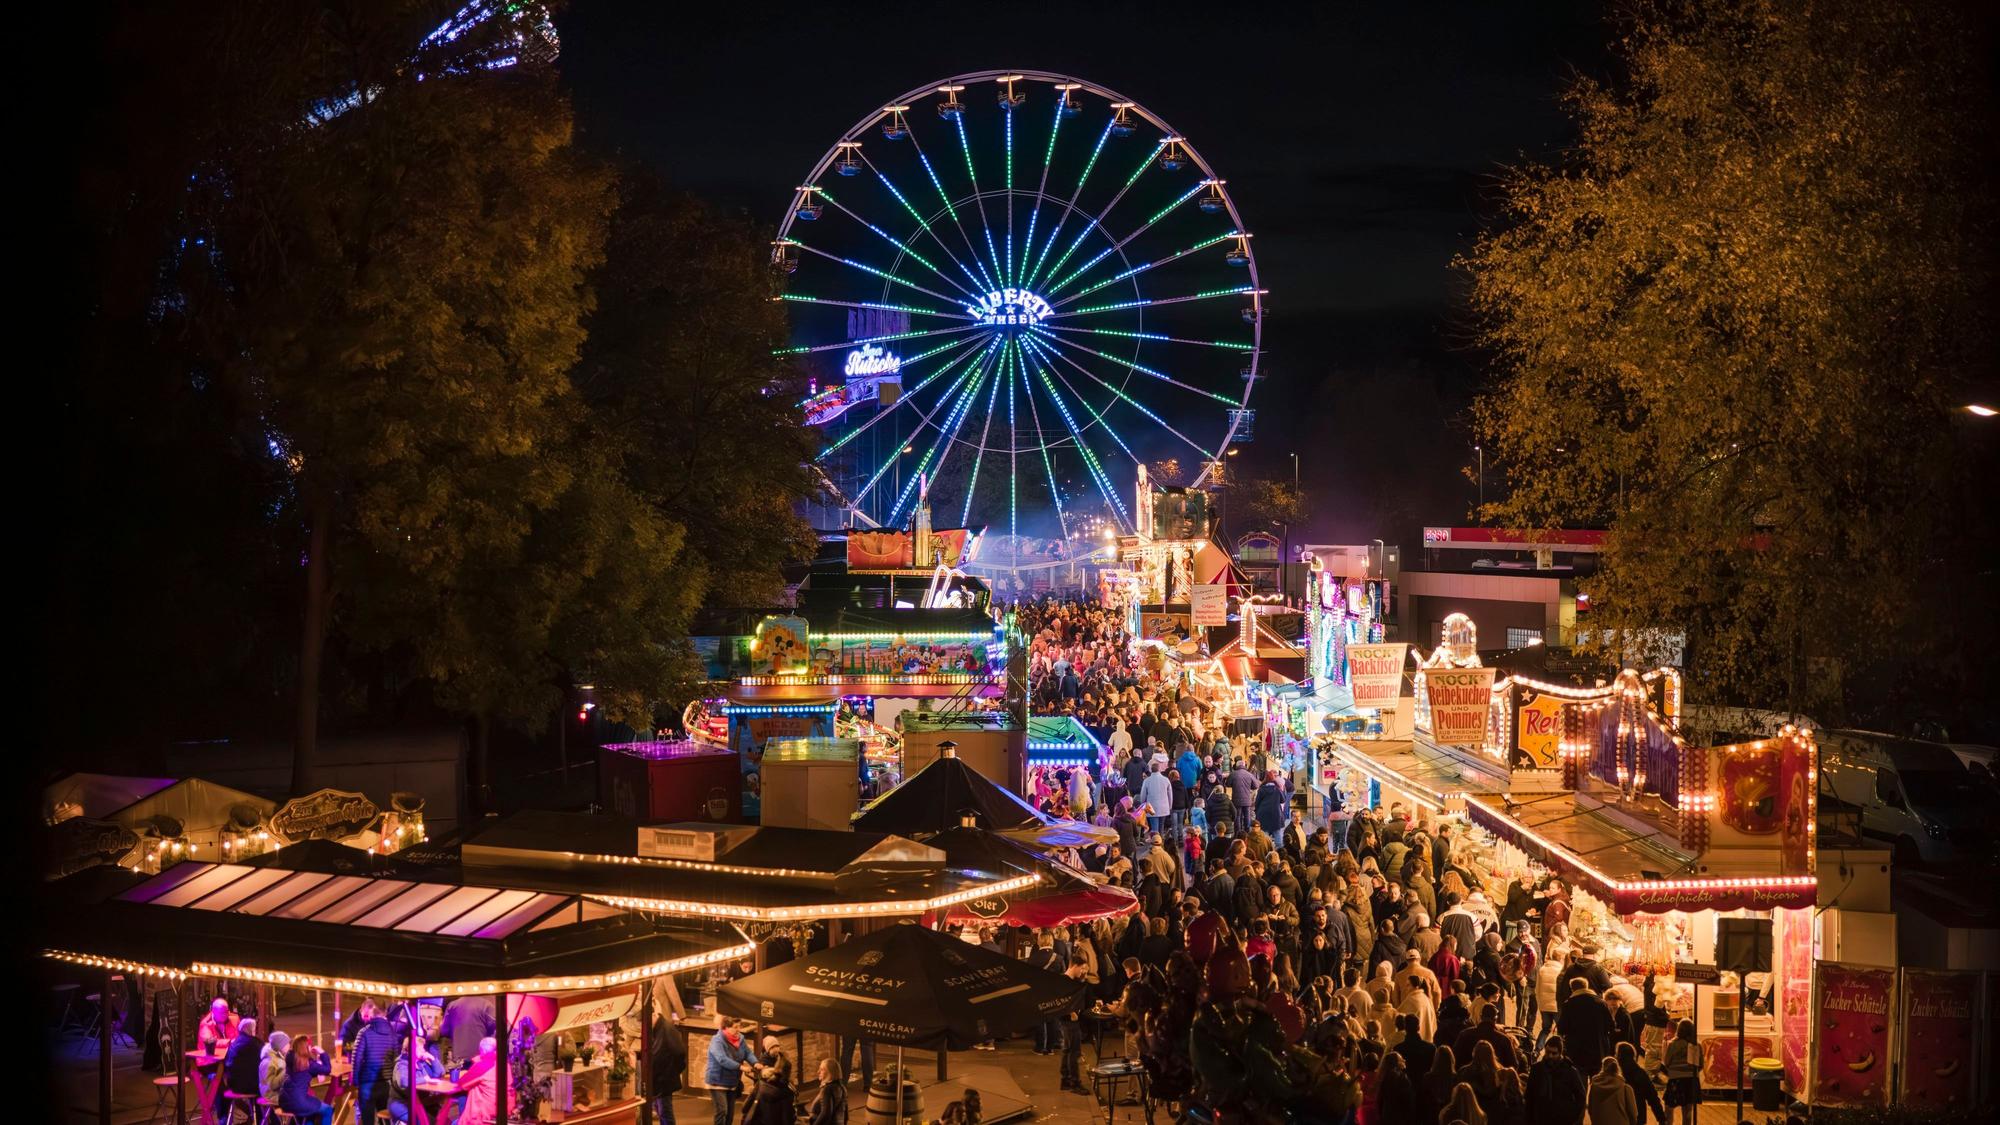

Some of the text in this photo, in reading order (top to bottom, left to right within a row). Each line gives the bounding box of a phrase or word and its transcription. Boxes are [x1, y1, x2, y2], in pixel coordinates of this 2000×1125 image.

[966, 288, 1055, 321] LIBERTY
[984, 312, 1038, 325] WHEEL
[845, 350, 901, 376] Rutsche
[1350, 657, 1400, 675] Backfisch
[1353, 683, 1398, 700] Calamares
[1428, 685, 1490, 706] Reibekuchen
[1437, 709, 1483, 730] Pommes
[1524, 709, 1560, 735] Rei
[1639, 888, 1801, 907] Schokofrüchte Popcorn
[813, 978, 882, 993] PROSECCO
[1823, 990, 1853, 1011] Zucker
